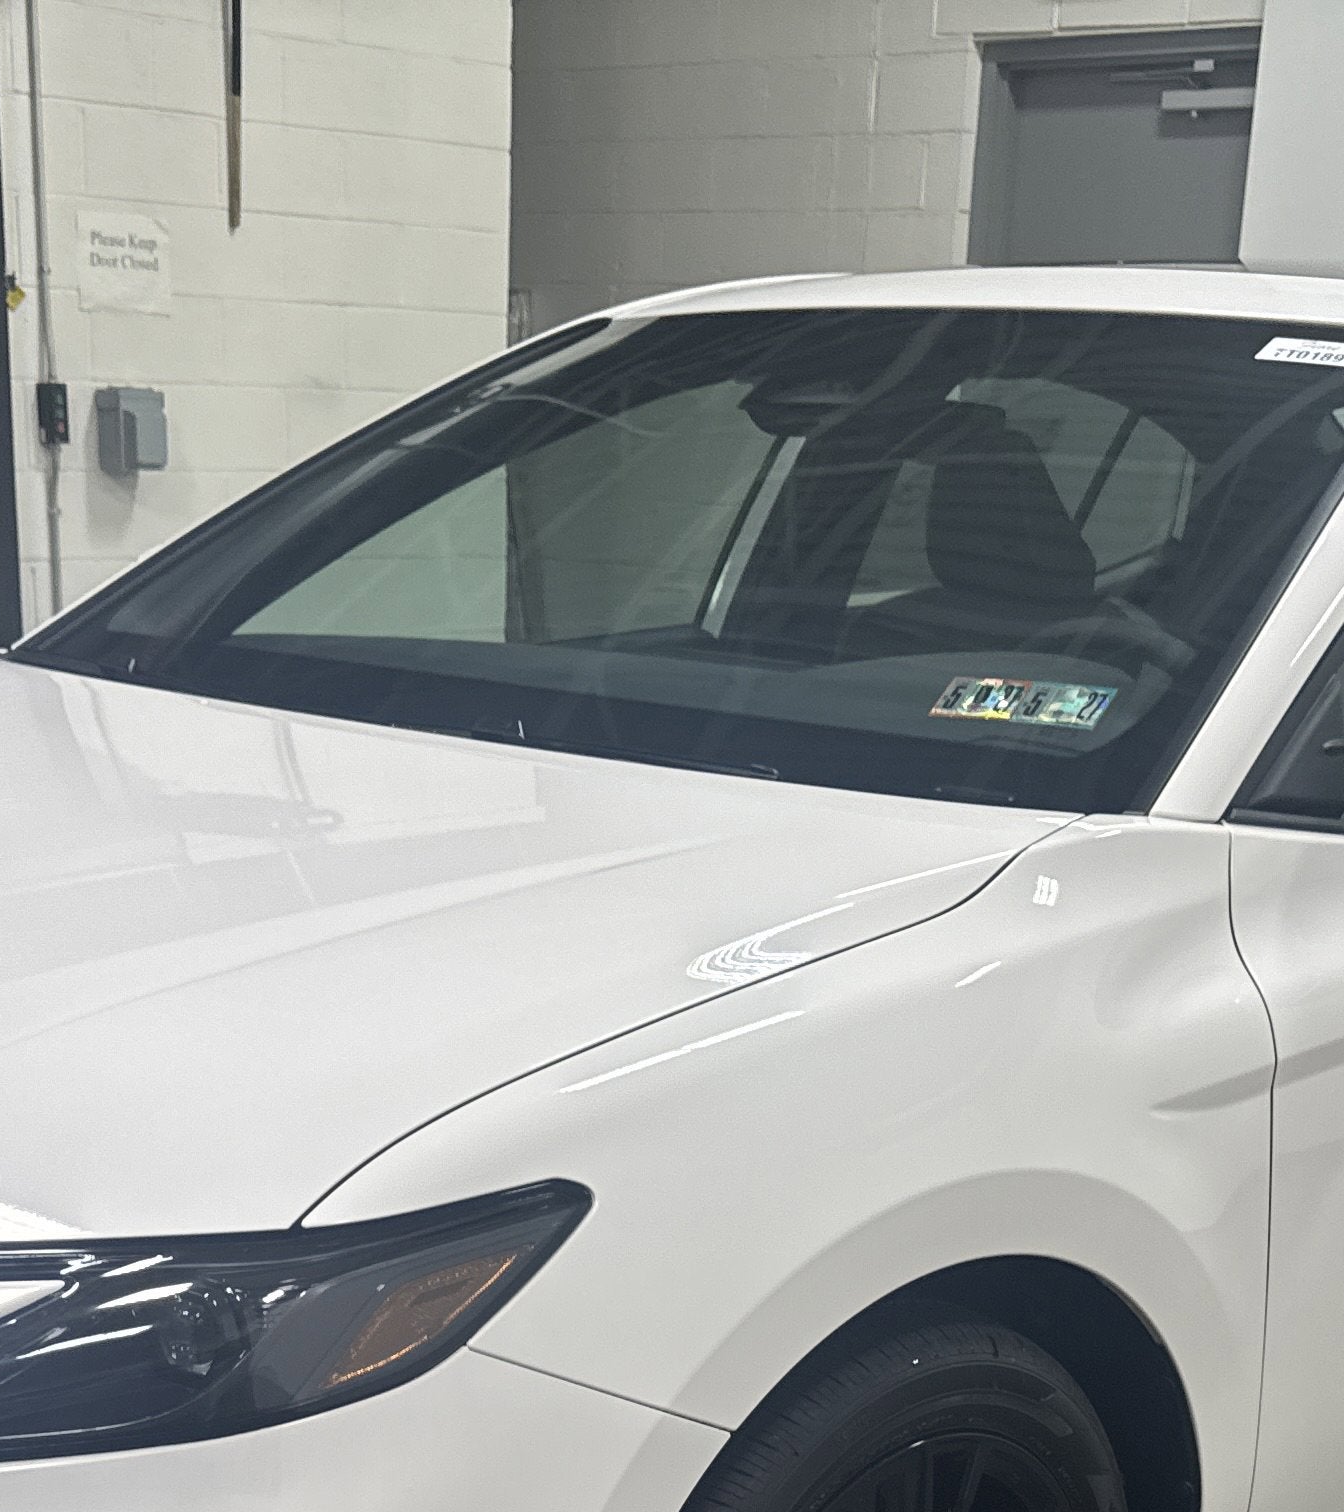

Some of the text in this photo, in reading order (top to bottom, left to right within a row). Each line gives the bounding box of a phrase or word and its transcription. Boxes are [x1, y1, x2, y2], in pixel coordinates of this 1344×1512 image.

[90, 231, 157, 254] Please Keep
[89, 251, 159, 272] Door Closed
[1023, 687, 1048, 717] 5
[1076, 691, 1109, 722] 27
